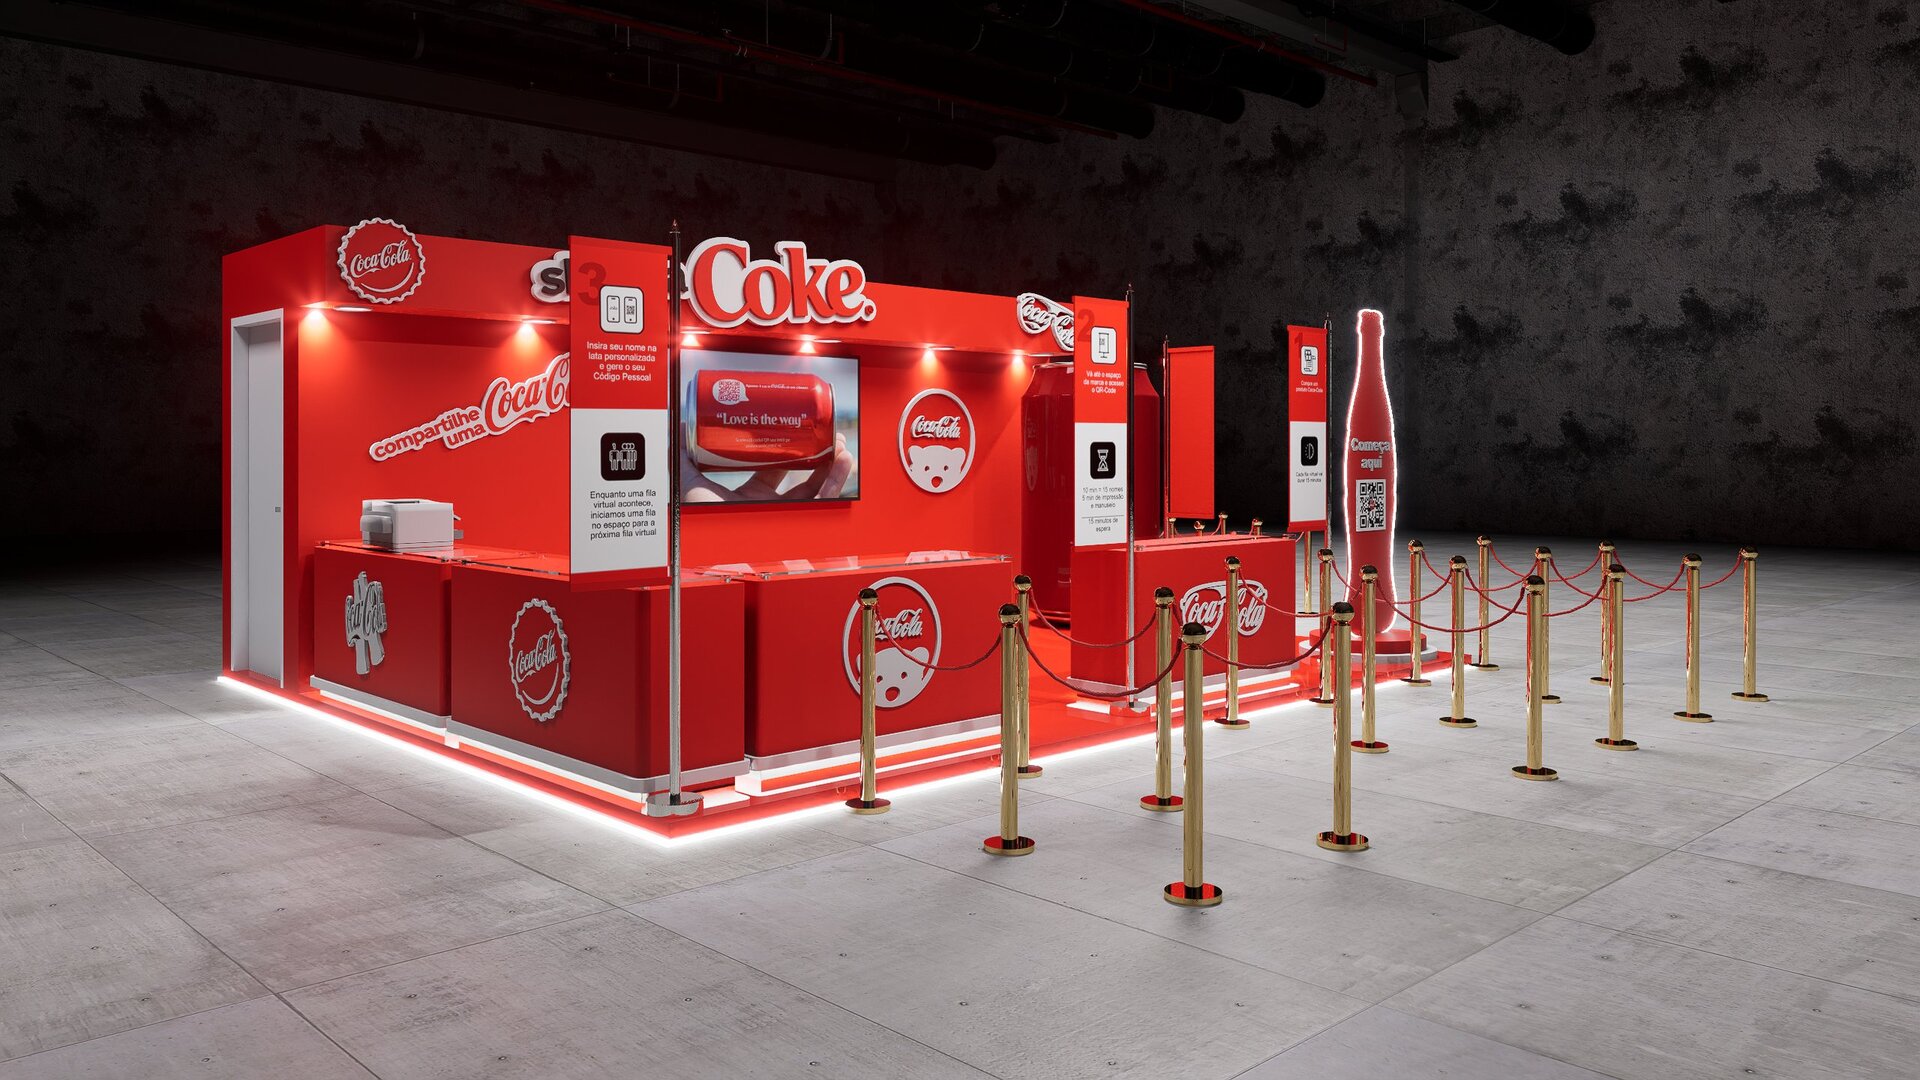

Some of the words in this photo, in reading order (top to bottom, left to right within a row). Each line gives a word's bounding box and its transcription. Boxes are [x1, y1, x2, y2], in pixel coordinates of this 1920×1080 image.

[350, 239, 411, 278] Coca-Cola
[578, 262, 606, 305] 3
[1078, 309, 1095, 342] 2
[586, 342, 608, 350] Insira
[604, 353, 656, 362] personalizada
[594, 372, 620, 382] Código
[622, 372, 651, 382] Pessoal
[484, 356, 570, 433] Coca-C
[750, 413, 758, 424] is
[761, 414, 777, 425] the
[912, 415, 960, 438] Coca-Cola
[374, 409, 480, 458] compartilhe
[447, 423, 486, 446] uma
[1351, 438, 1390, 454] Começa
[1361, 456, 1382, 471] aqui
[590, 491, 626, 500] Enquanto
[590, 510, 626, 519] iniciamos
[604, 521, 630, 530] espaço
[590, 531, 620, 540] próxima
[635, 528, 656, 537] virtual
[516, 628, 558, 683] Coca-Cola
